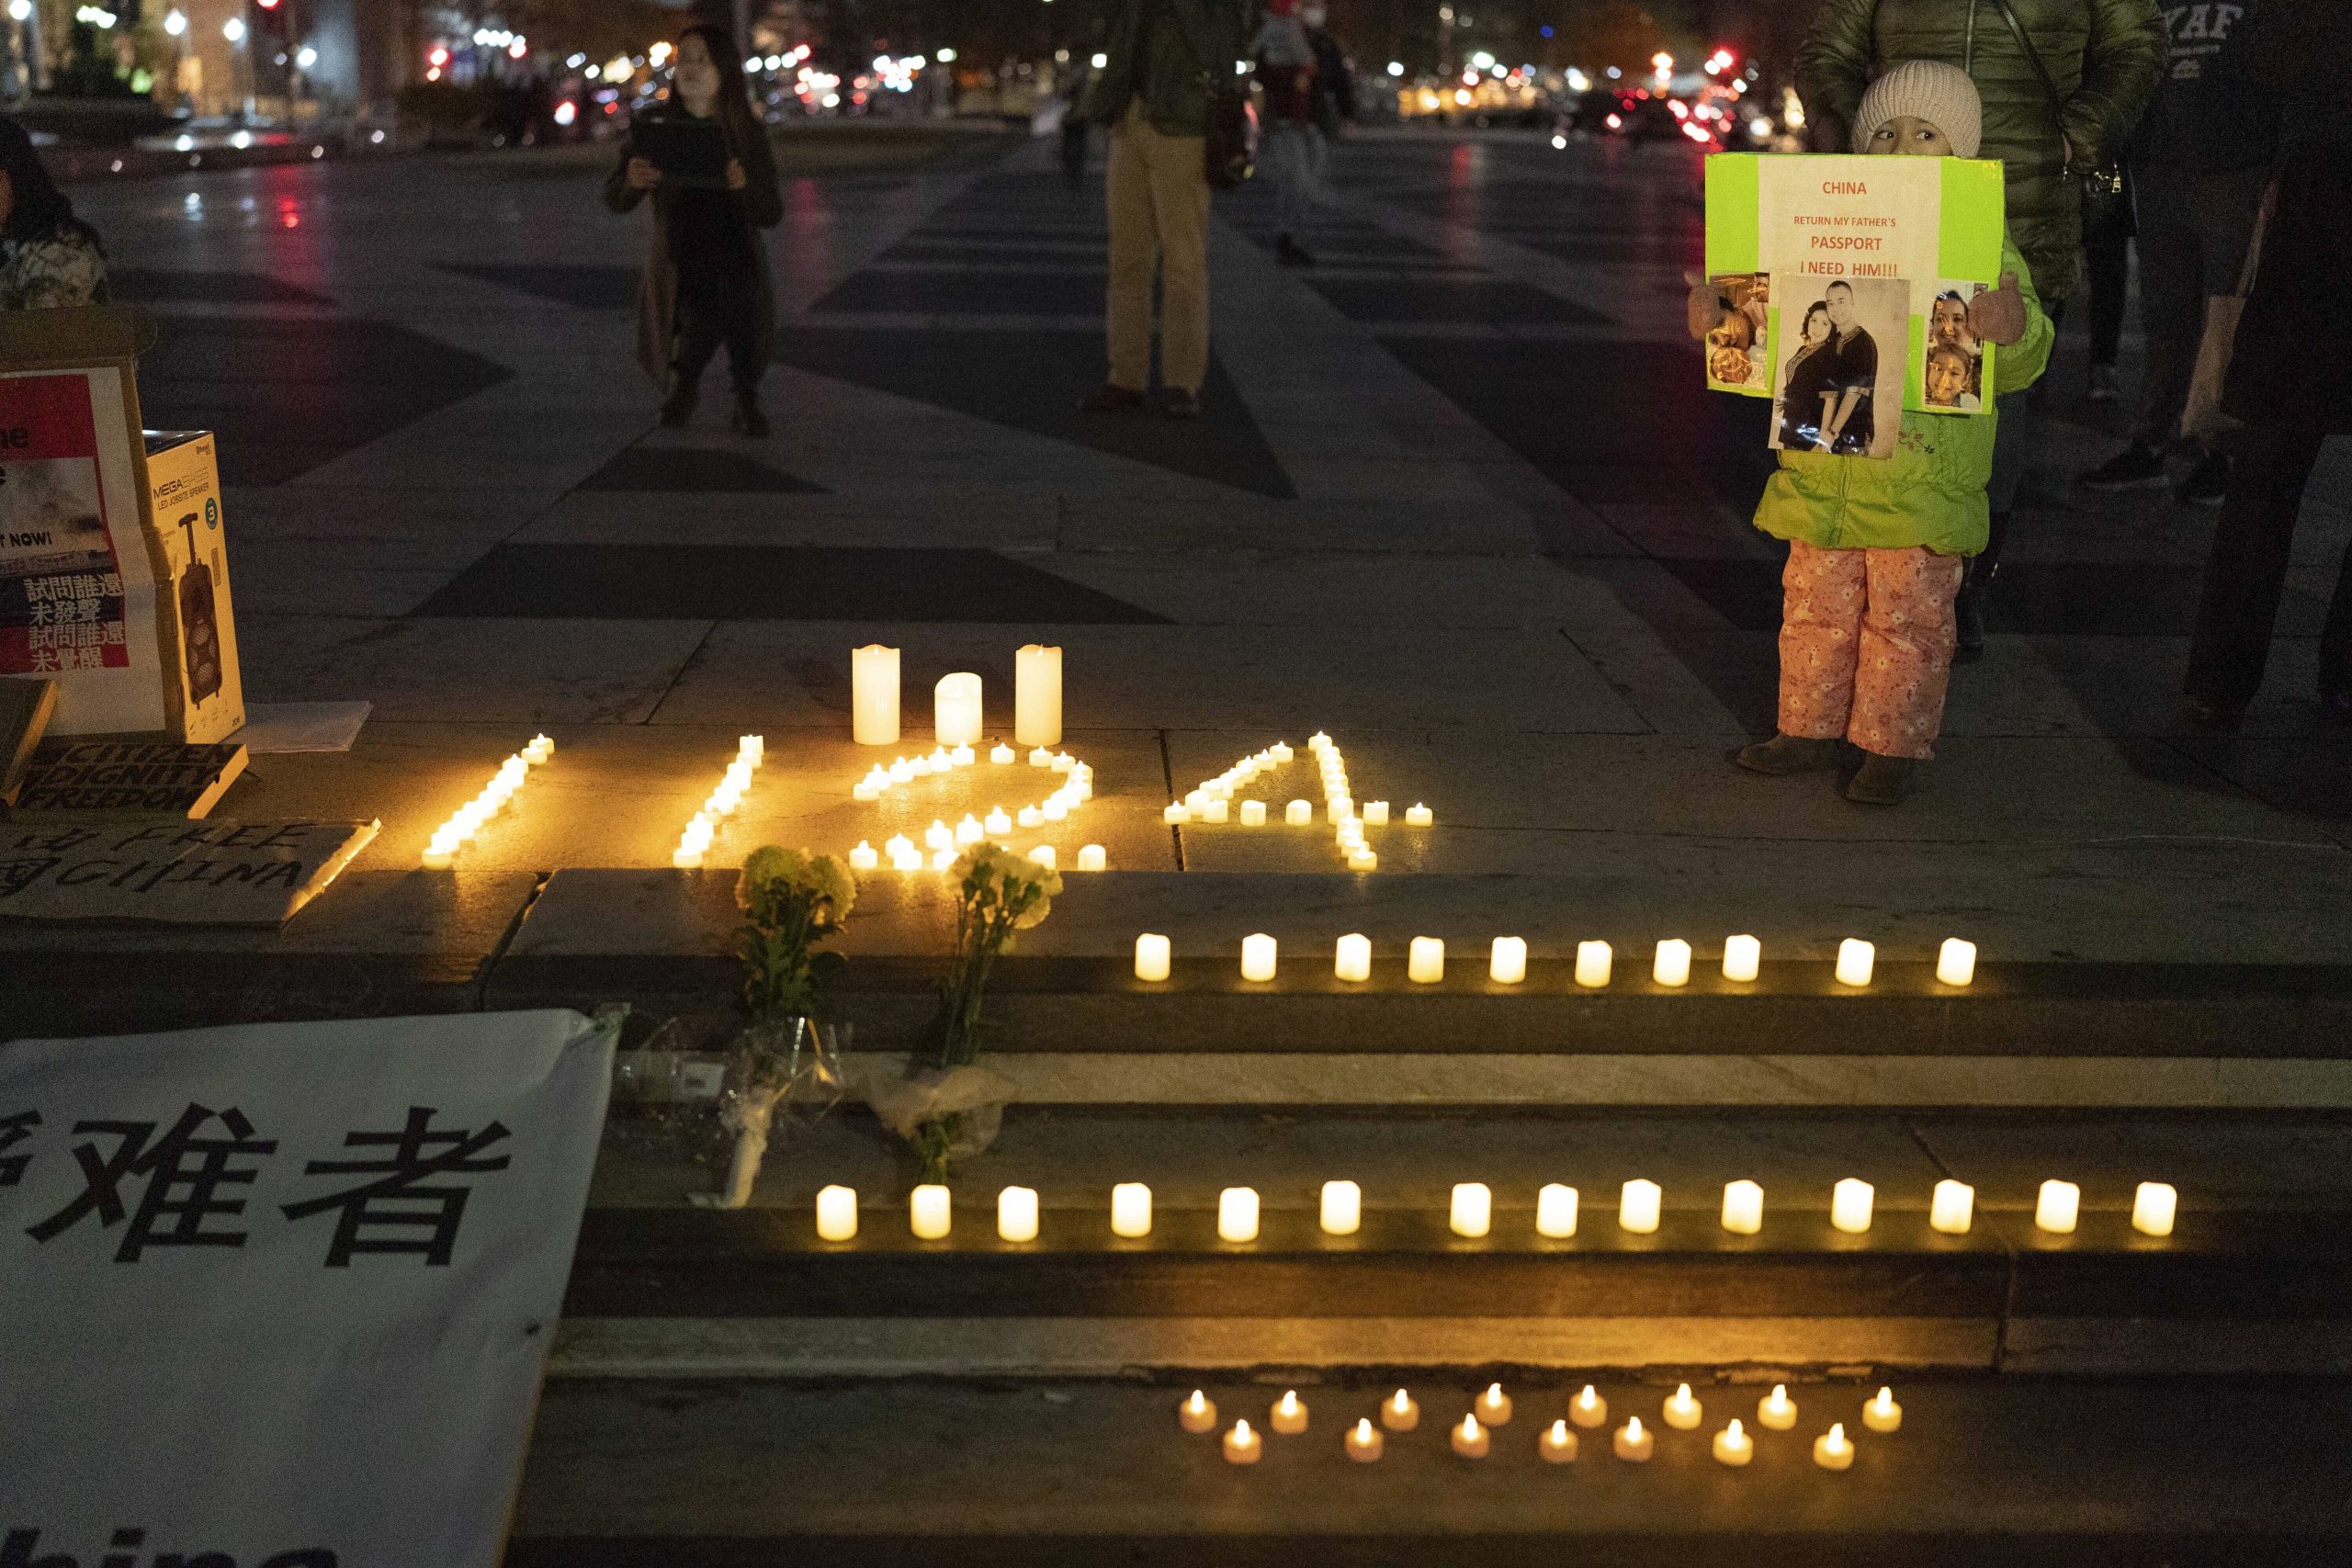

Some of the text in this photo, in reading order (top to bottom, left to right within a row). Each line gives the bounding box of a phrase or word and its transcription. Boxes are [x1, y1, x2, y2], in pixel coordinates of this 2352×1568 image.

[1822, 181, 1867, 195] CHINA
[1793, 216, 1831, 226] RETURN
[1833, 217, 1849, 226] MY
[1811, 236, 1883, 250] PASSPORT
[1808, 262, 1845, 276] NEED
[1852, 262, 1897, 276] HIM!!!
[189, 481, 209, 498] SPEAKER
[9, 530, 52, 547] NOW!
[63, 743, 243, 763] CITIZEN
[40, 764, 224, 784] DIGNITY
[20, 787, 202, 809] FREEDOM
[109, 823, 318, 852] FREE
[55, 860, 304, 894] CHINA
